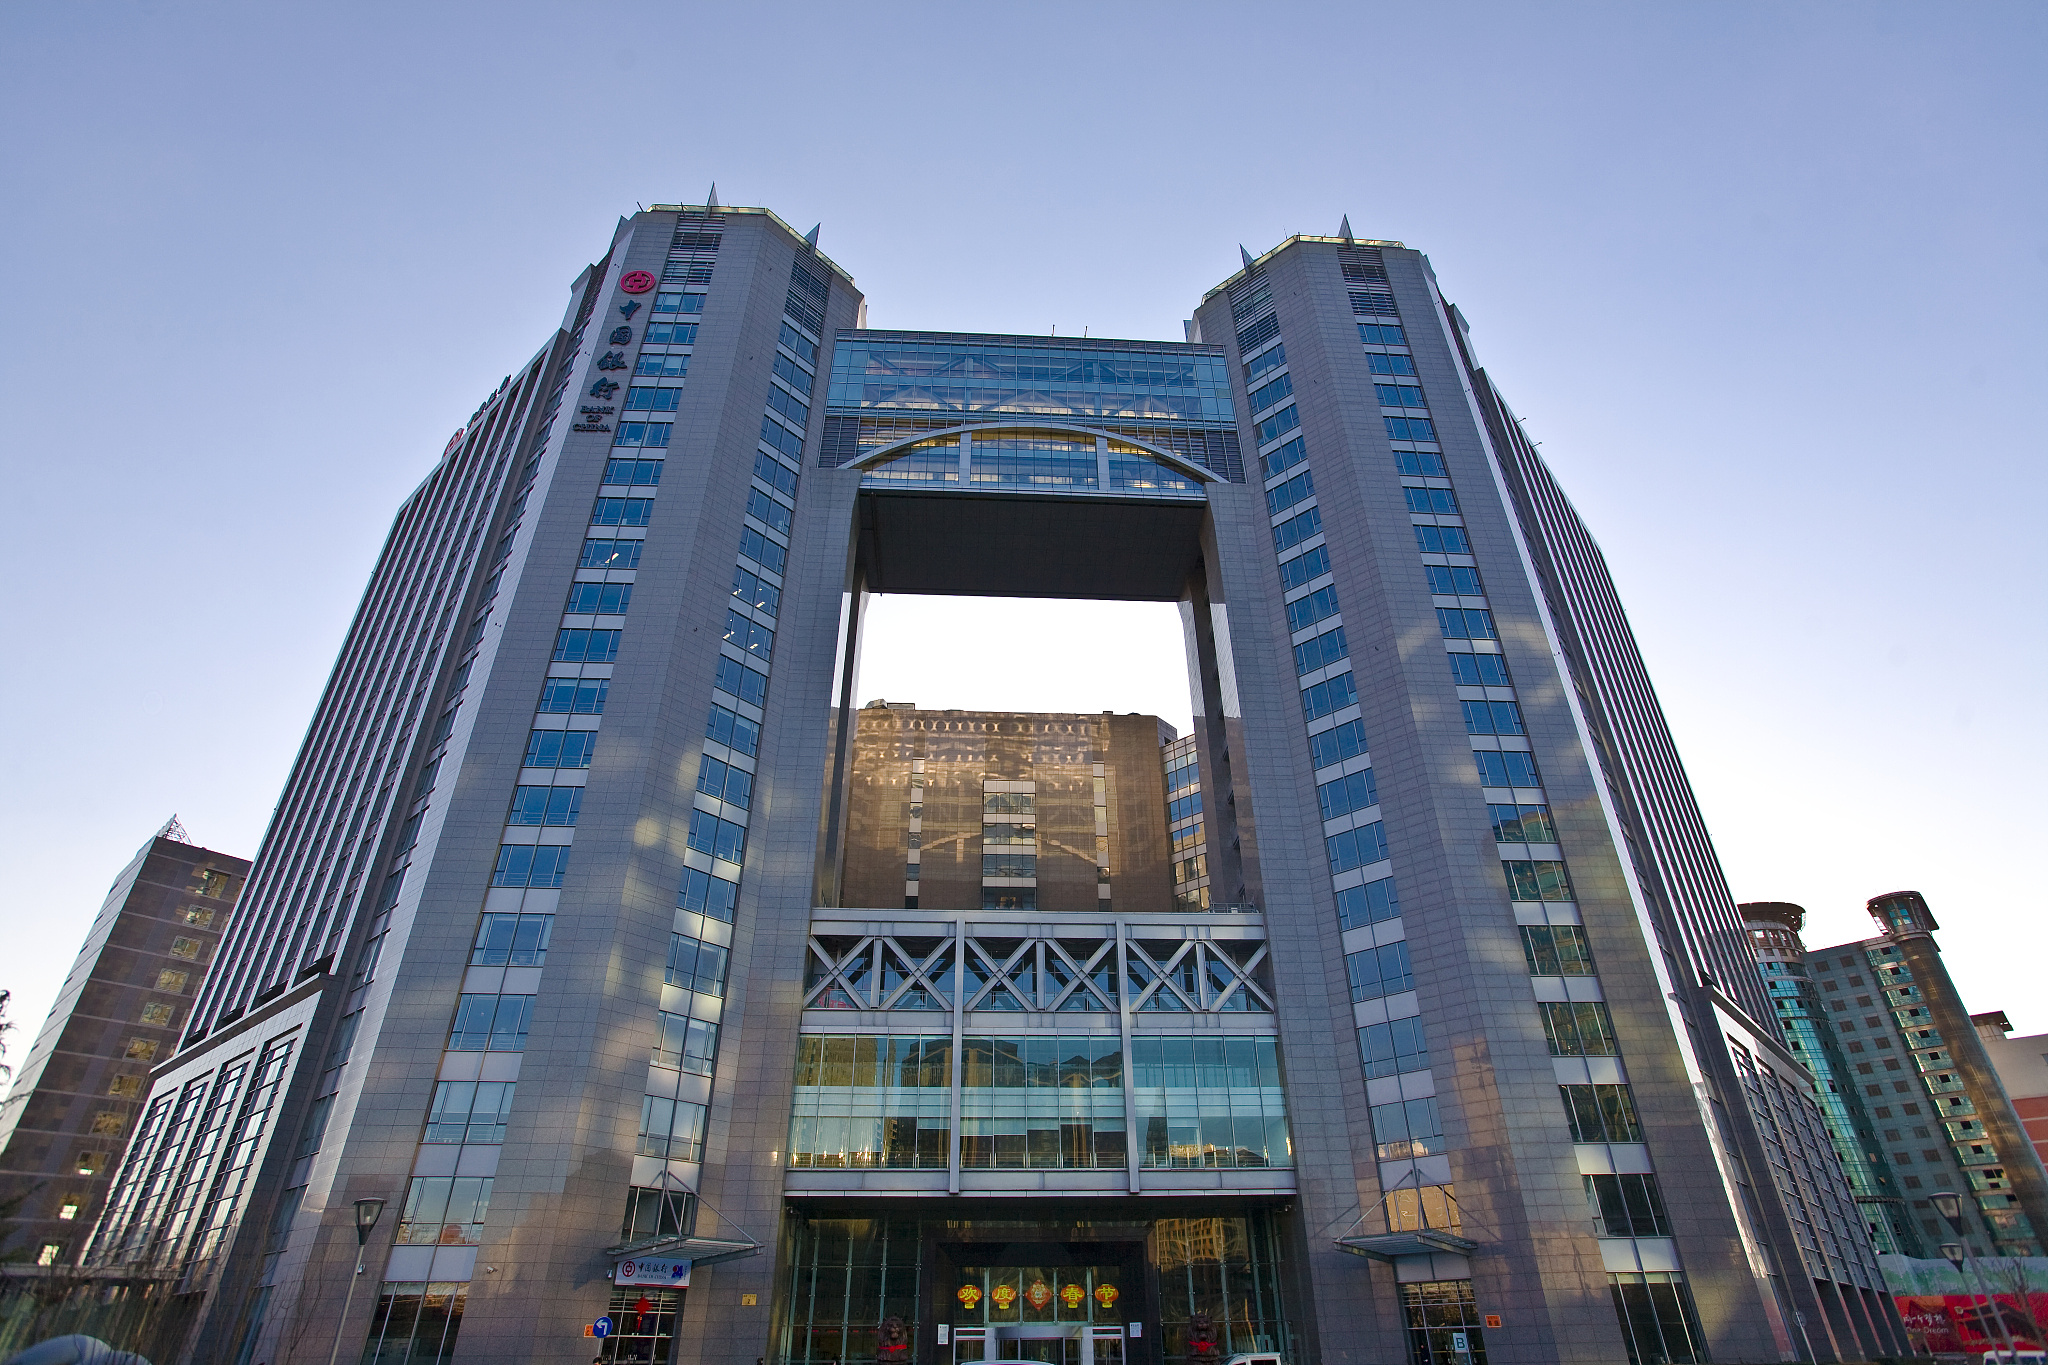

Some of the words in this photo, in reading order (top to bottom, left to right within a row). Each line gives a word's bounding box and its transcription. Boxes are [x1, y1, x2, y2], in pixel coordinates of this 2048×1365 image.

[580, 405, 615, 414] BANK
[586, 414, 603, 423] OF
[573, 423, 611, 432] CHINA
[1923, 1326, 1949, 1334] Dream
[1455, 1337, 1466, 1349] B
